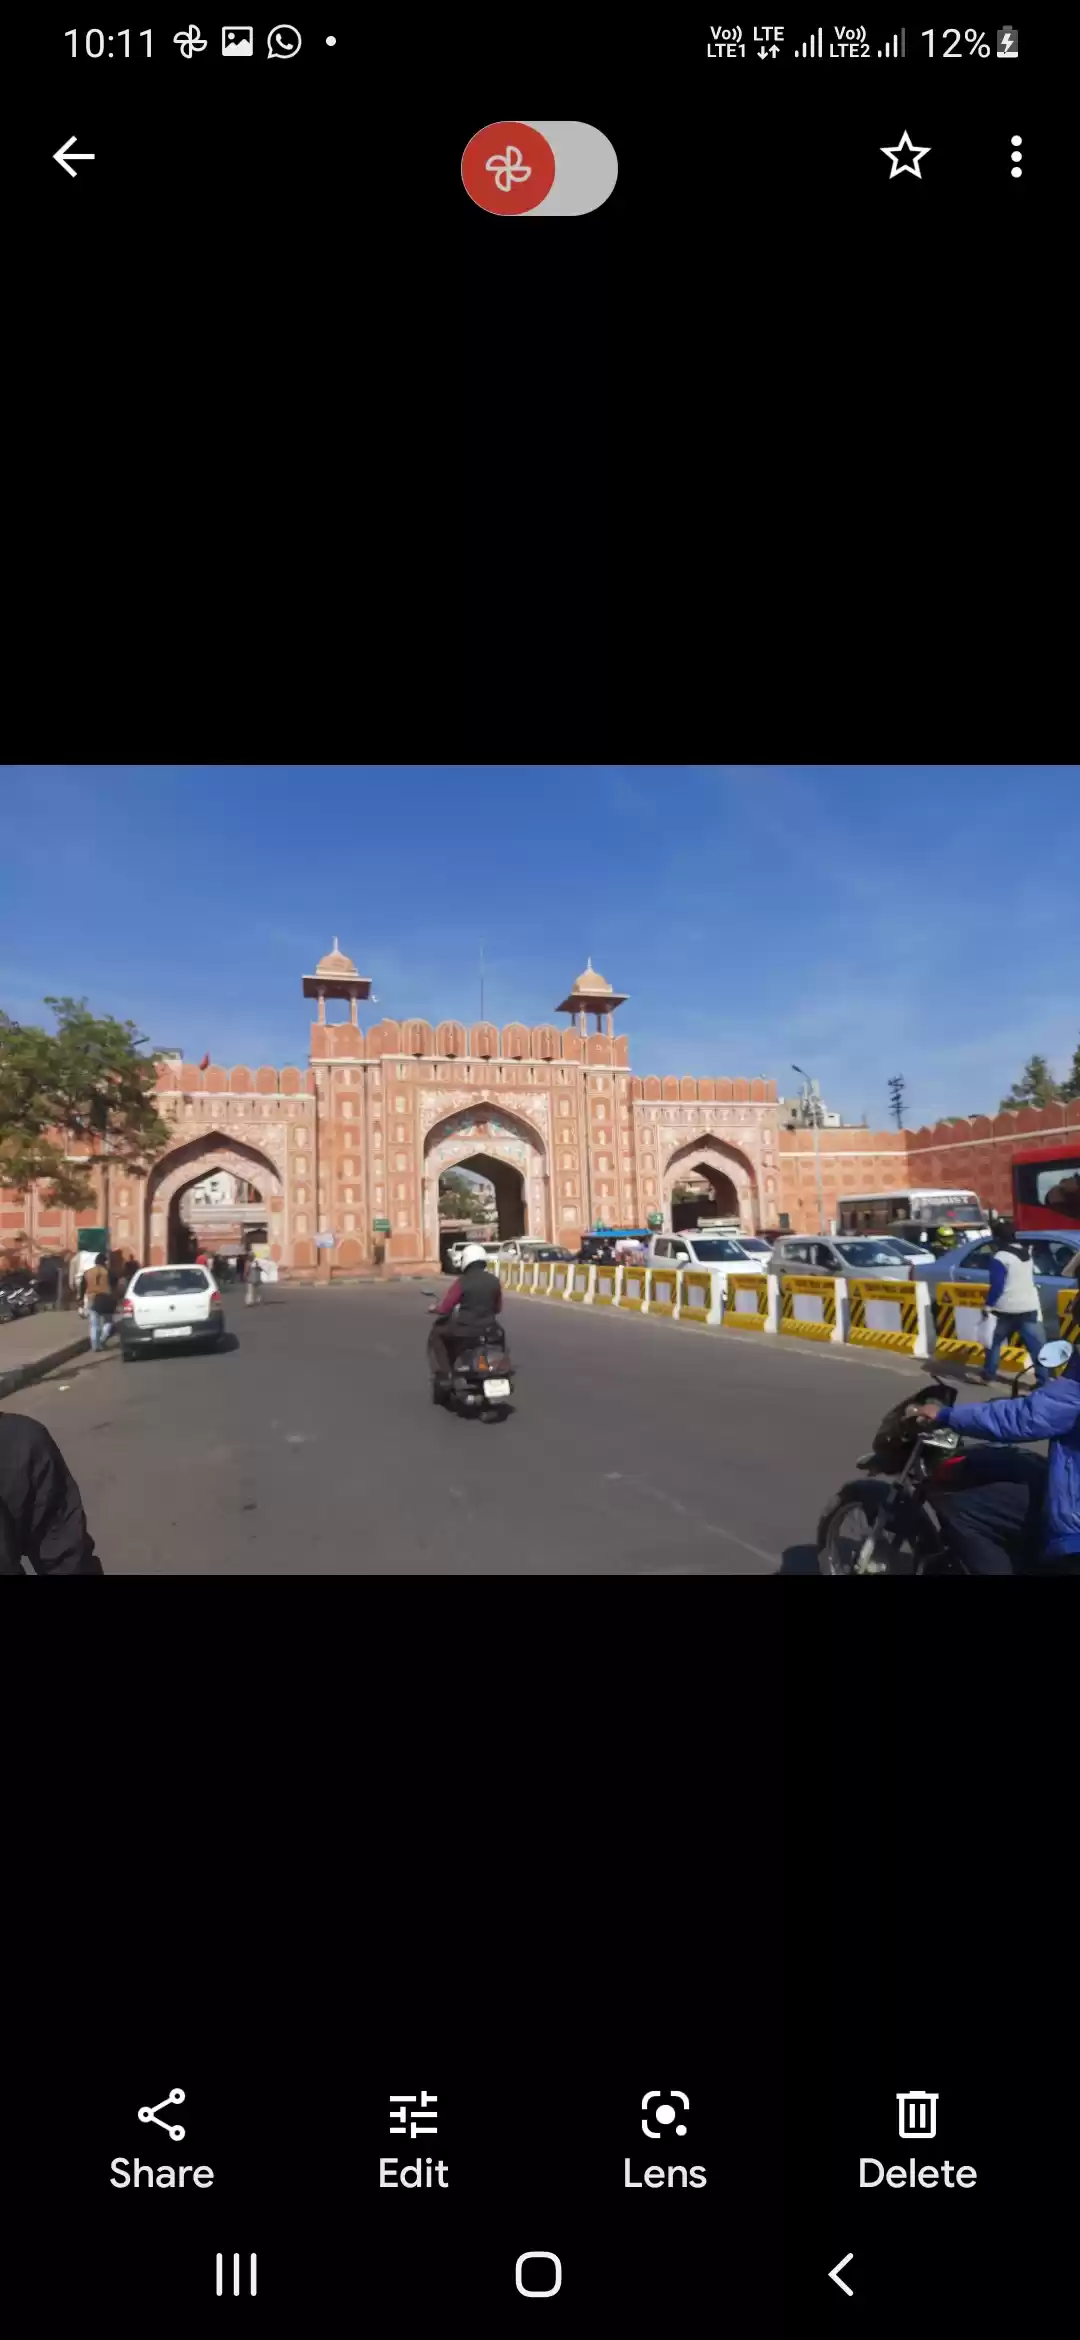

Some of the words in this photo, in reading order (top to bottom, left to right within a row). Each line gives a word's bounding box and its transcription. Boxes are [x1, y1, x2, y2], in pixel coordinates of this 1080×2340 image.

[64, 28, 152, 58] 10:11
[753, 27, 785, 41] LTE
[921, 28, 991, 58] 12%
[707, 44, 746, 58] LTE1
[829, 44, 871, 58] LTE2
[109, 2157, 215, 2189] Share
[379, 2157, 449, 2189] Edit
[624, 2157, 708, 2189] Lens
[859, 2157, 978, 2189] Delete
